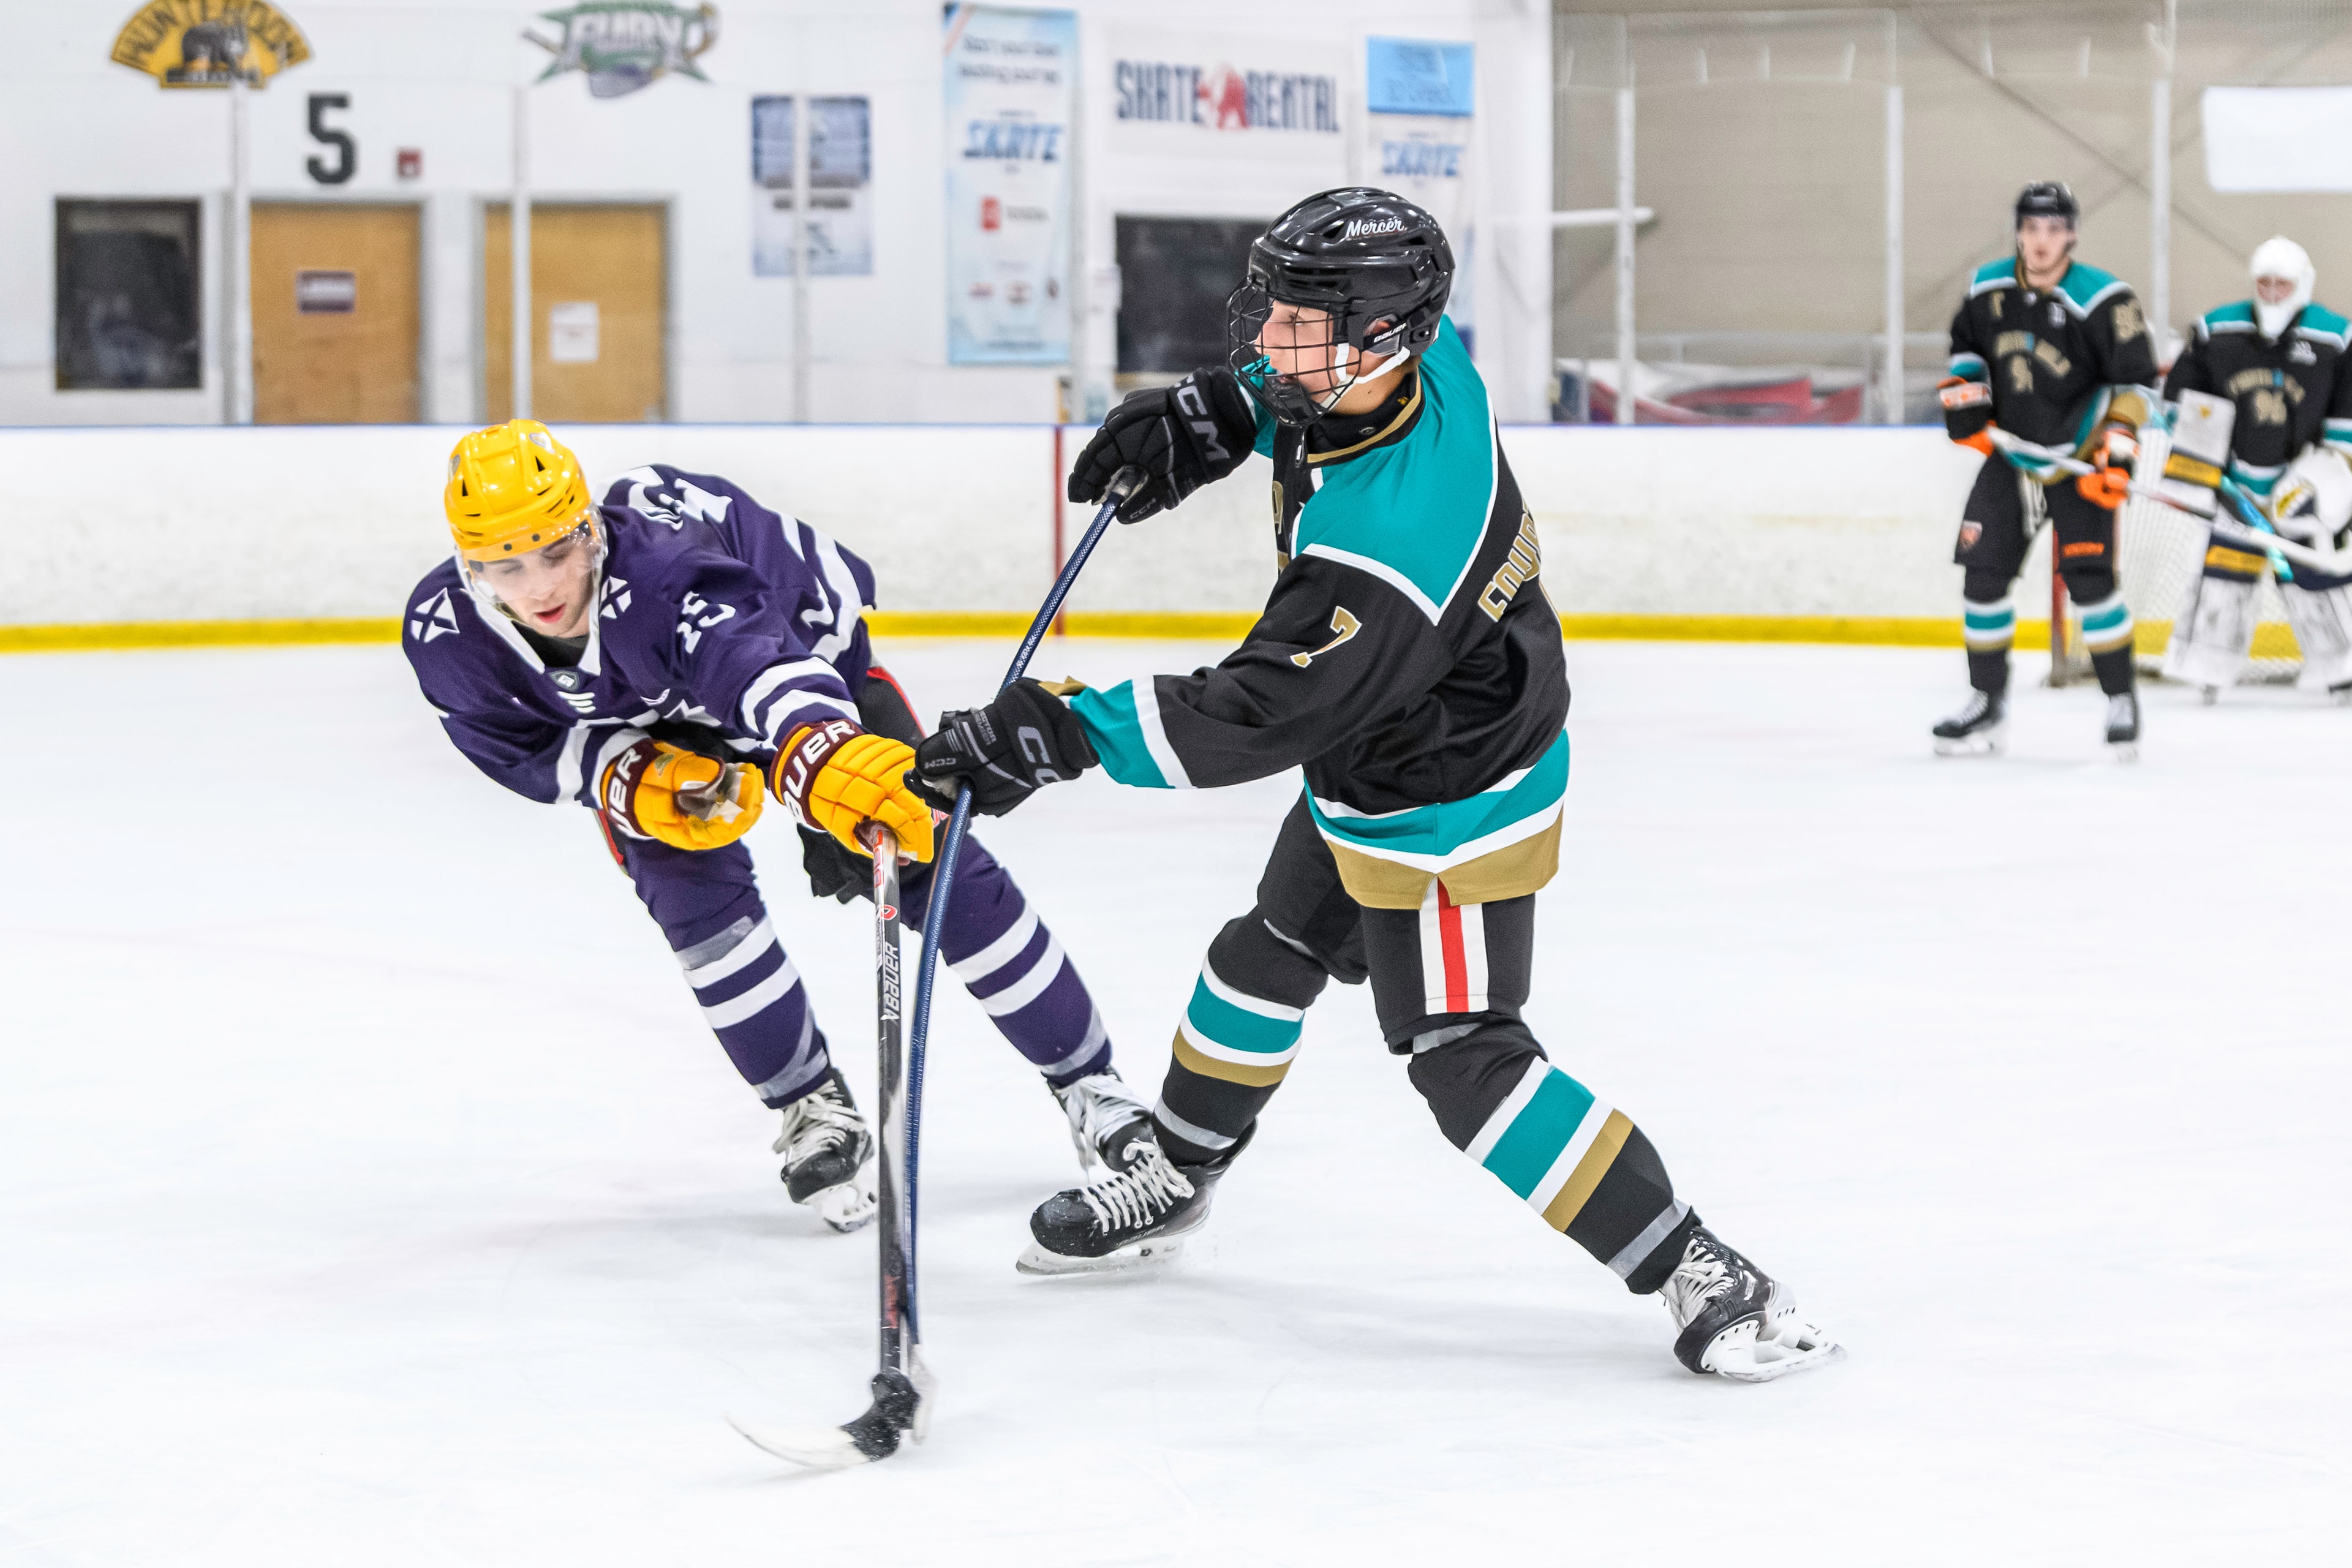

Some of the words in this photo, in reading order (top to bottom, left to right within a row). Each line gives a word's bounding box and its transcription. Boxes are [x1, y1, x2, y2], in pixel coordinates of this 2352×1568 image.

[1115, 59, 1205, 126] SKATE
[1245, 68, 1341, 134] RENTAL
[307, 92, 356, 185] 5
[1345, 216, 1406, 238] Mercer
[1174, 375, 1231, 460] CM
[1289, 605, 1363, 668] 7
[979, 709, 998, 742] ECTOR
[883, 941, 899, 1012] BAUER
